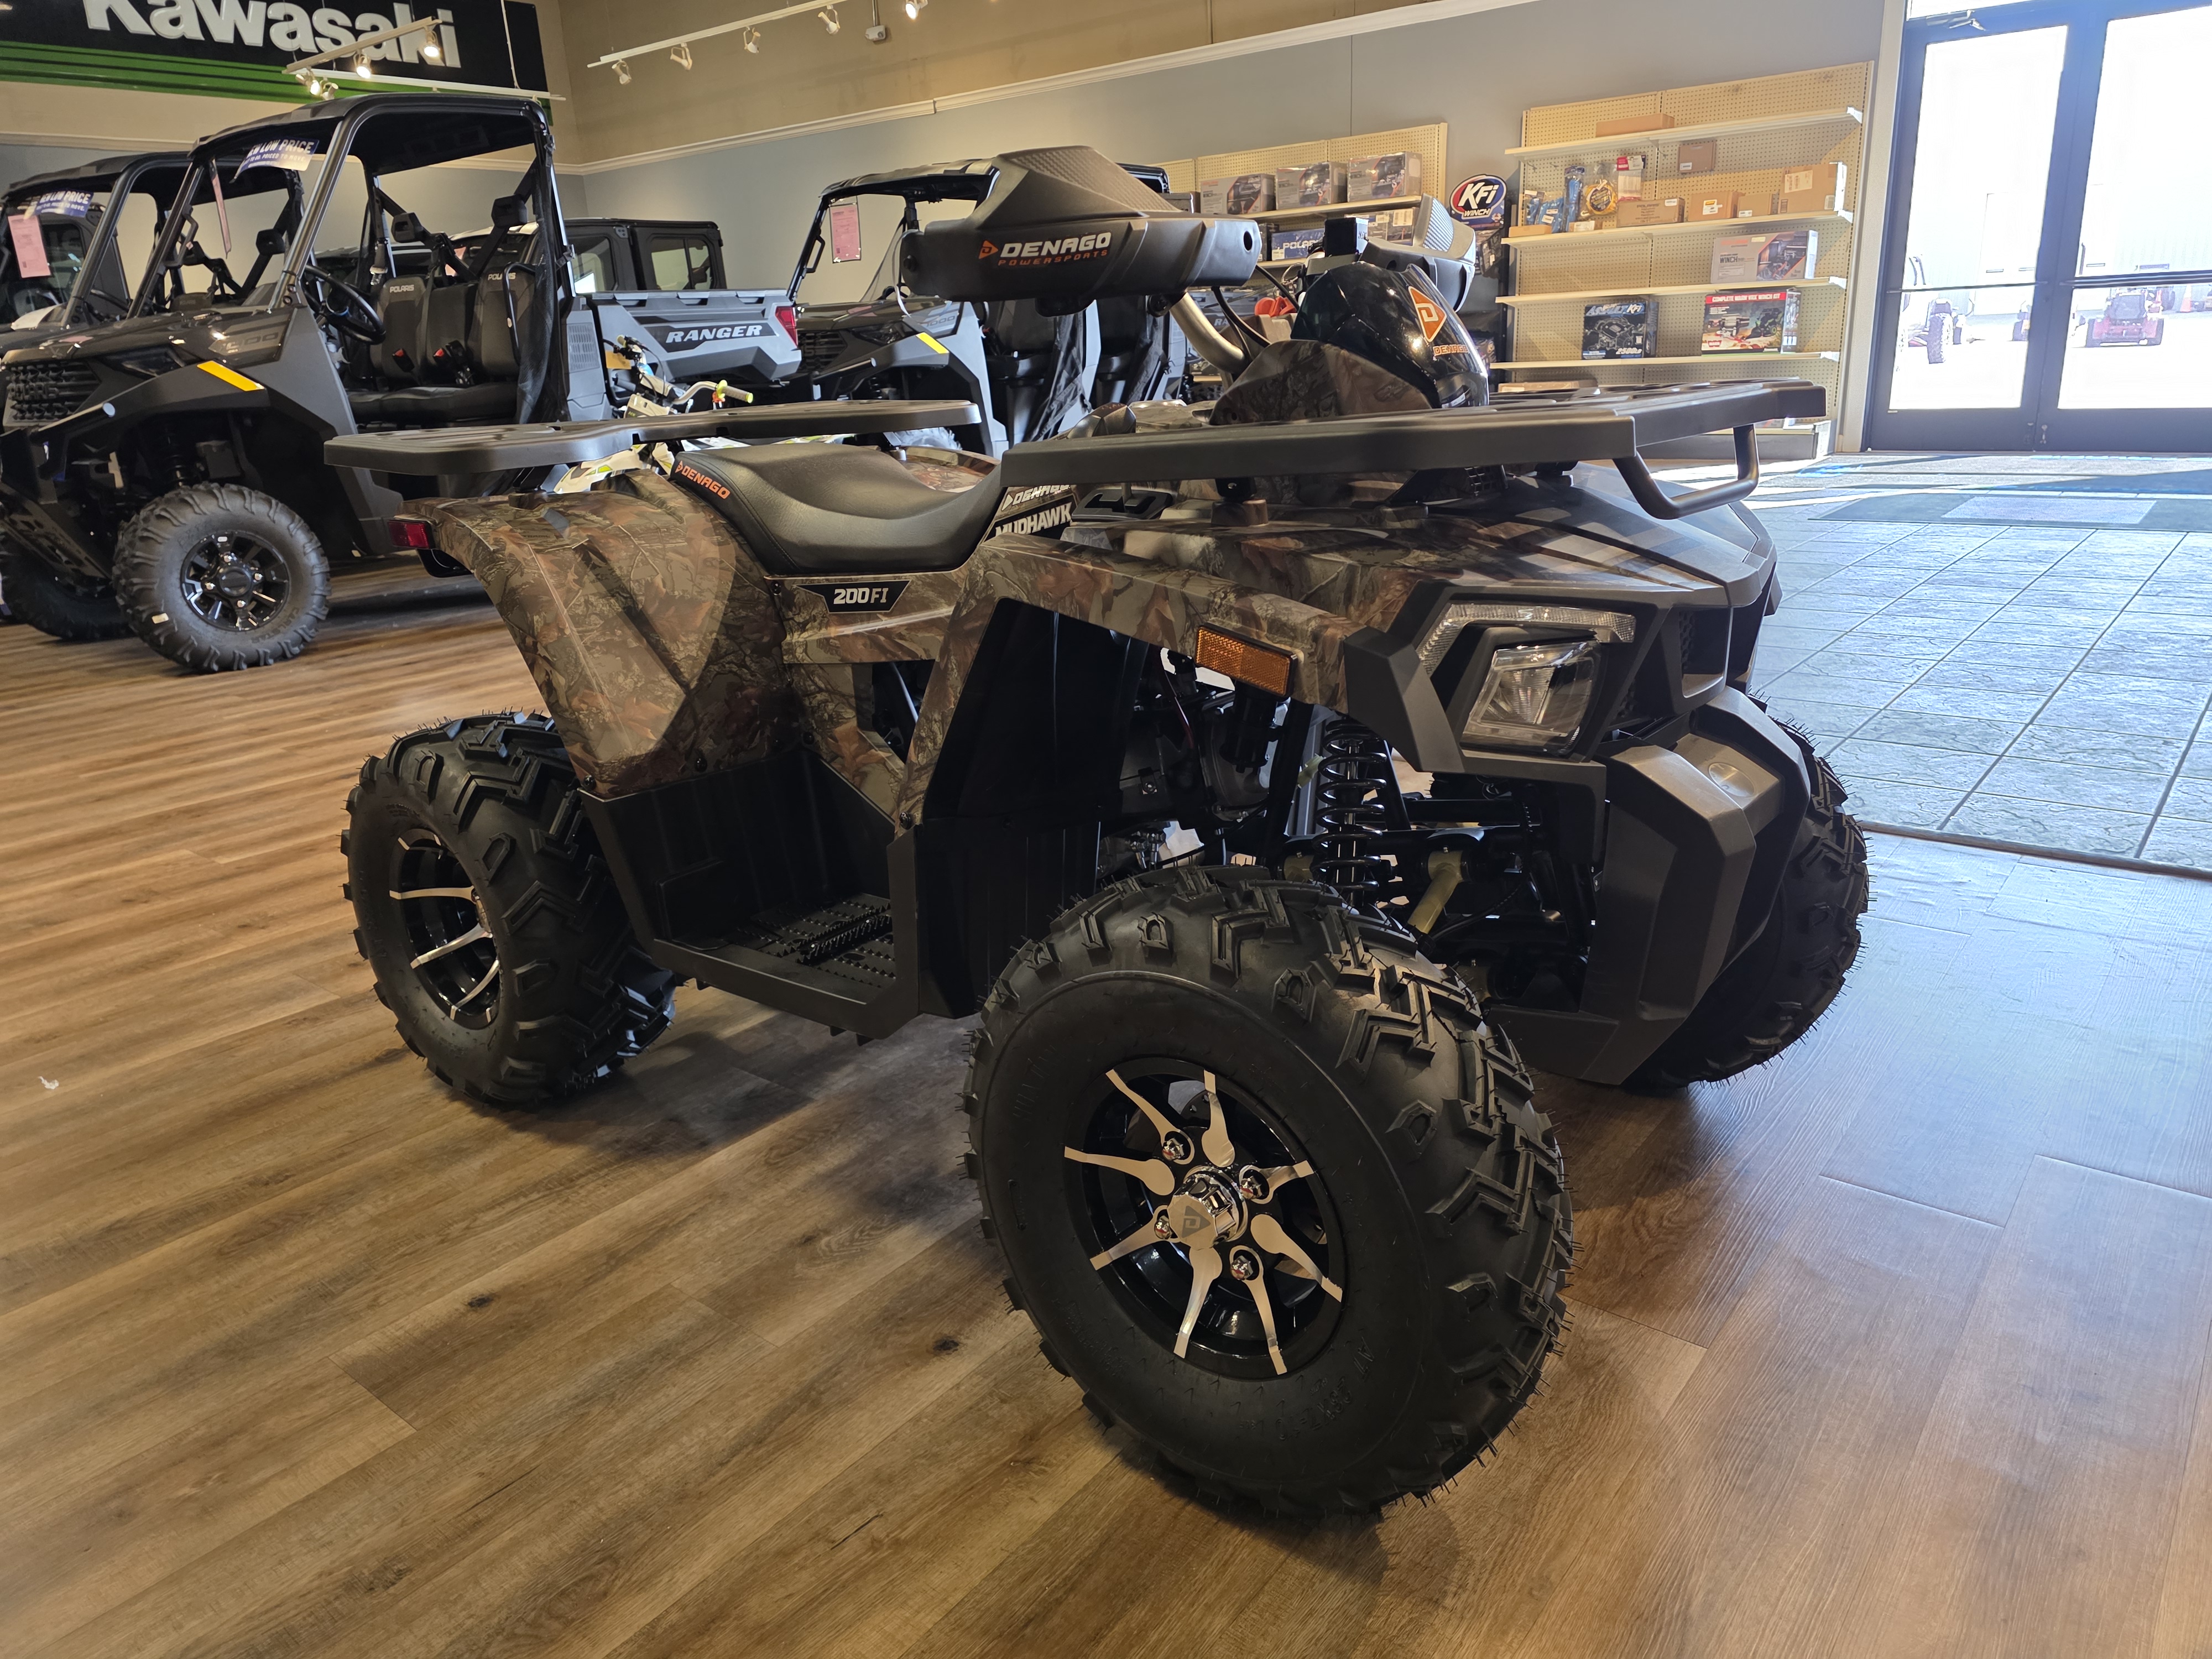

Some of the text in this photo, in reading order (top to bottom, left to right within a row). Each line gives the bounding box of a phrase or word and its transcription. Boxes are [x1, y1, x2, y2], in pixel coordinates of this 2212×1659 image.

[259, 139, 280, 153] LOW
[279, 139, 315, 154] PRICE
[63, 191, 91, 205] PRICE
[1464, 208, 1490, 217] WINCH
[1000, 232, 1112, 258] DENAGO
[1283, 239, 1319, 249] POLAR
[998, 249, 1108, 266] POWERSPORTS
[487, 272, 516, 281] POLIS
[389, 284, 414, 293] POLARIS
[665, 325, 763, 343] RANGER
[681, 465, 731, 499] DENAGO
[995, 502, 1072, 537] MUDHAWK
